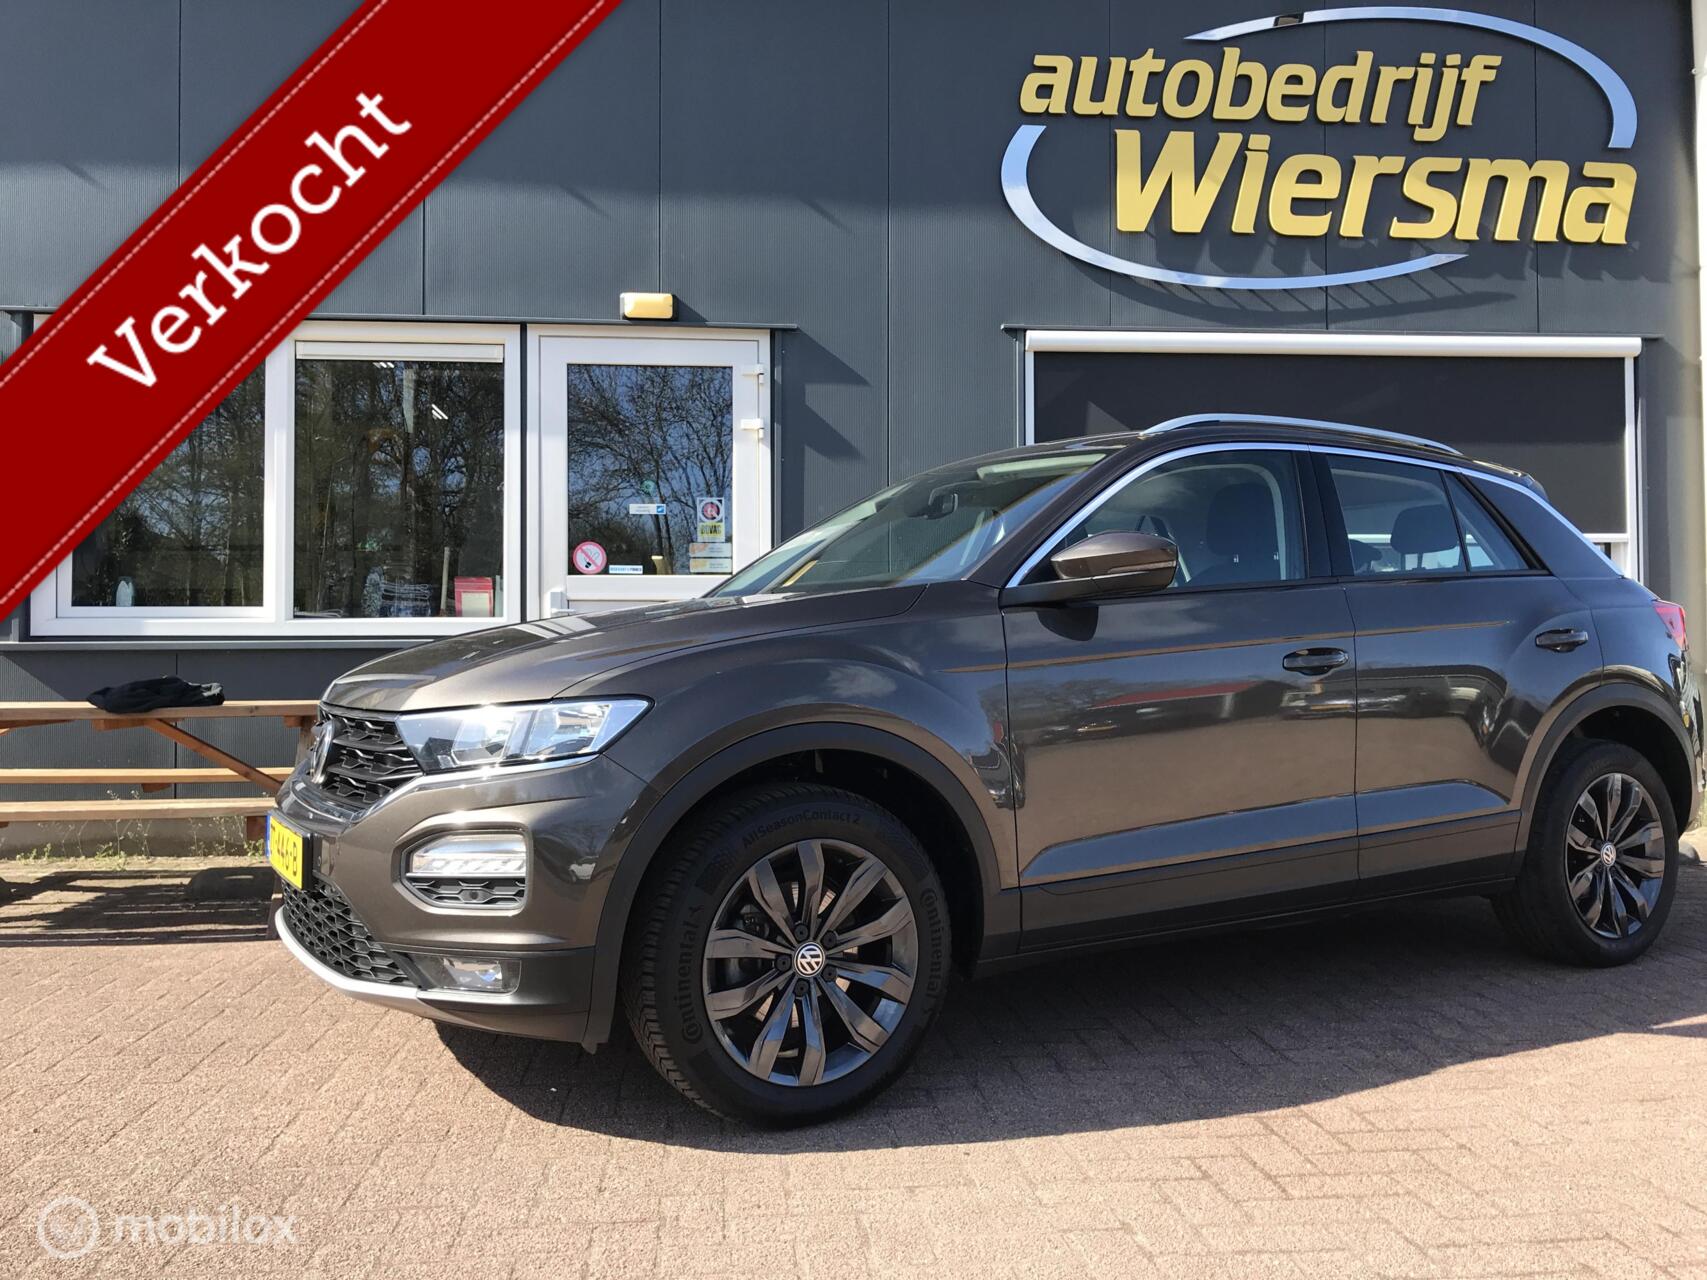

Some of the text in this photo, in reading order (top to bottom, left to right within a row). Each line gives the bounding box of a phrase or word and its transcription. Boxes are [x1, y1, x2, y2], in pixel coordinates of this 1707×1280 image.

[1020, 47, 1502, 143] autobedrijf
[1115, 129, 1638, 245] Wiersma
[673, 919, 704, 1044] Continental
